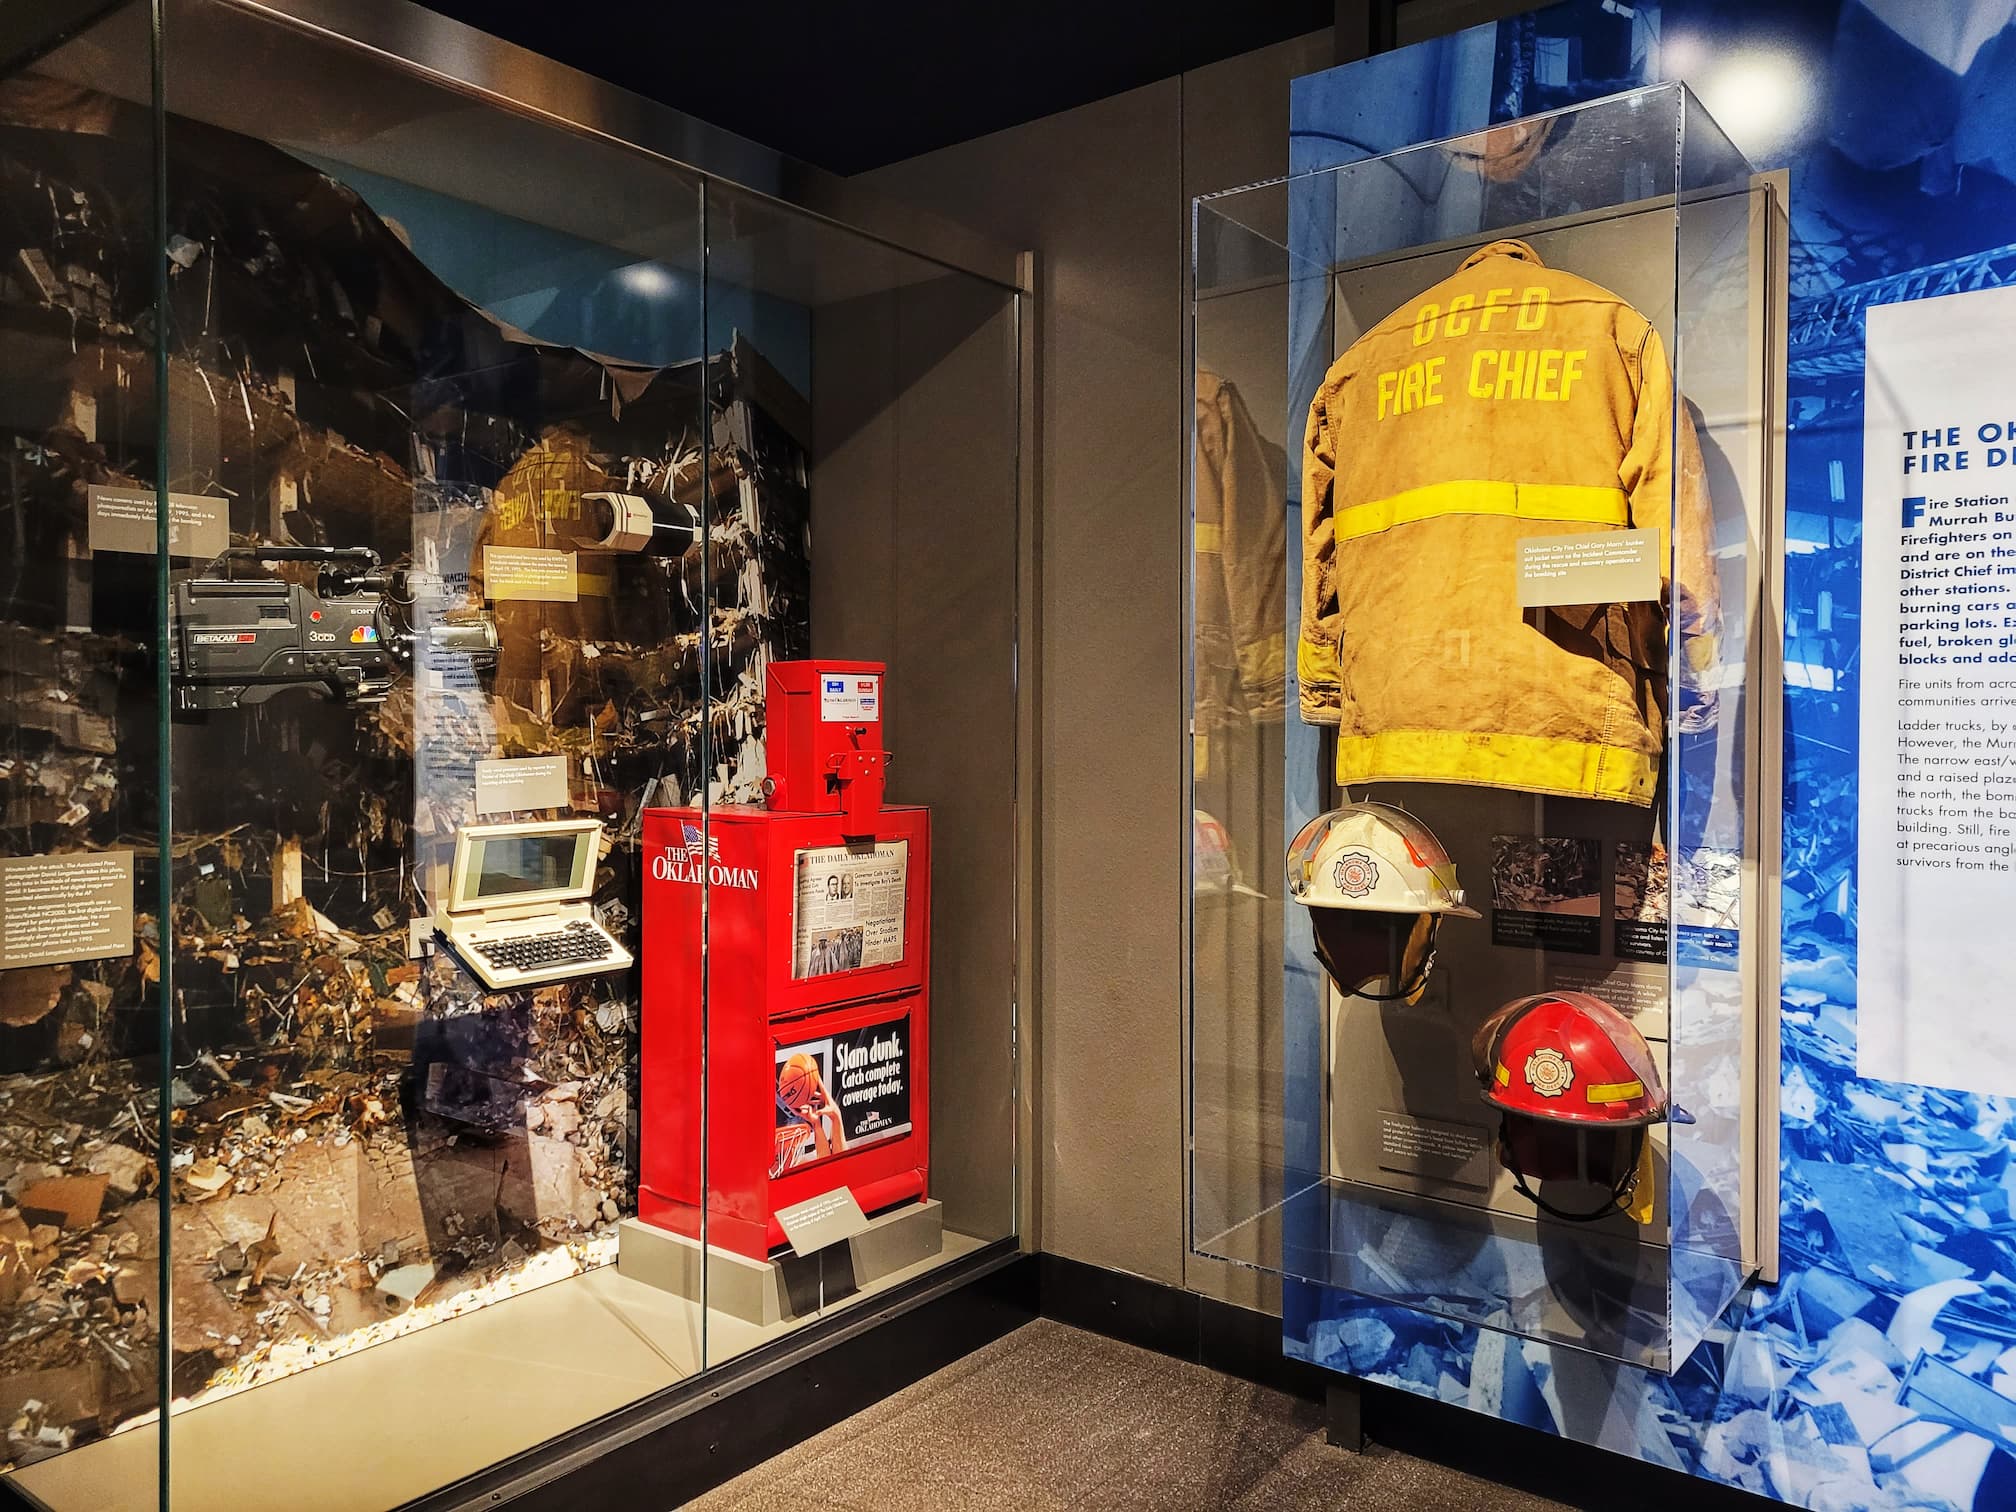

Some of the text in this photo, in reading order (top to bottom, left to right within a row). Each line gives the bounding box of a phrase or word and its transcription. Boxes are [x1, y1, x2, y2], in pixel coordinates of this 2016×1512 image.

[1413, 287, 1550, 347] OCFD
[1377, 350, 1587, 421] FIRE CHIEF
[1903, 427, 1960, 450] THE
[1904, 451, 1968, 474] FIRE
[1955, 495, 2008, 507] Station
[1930, 512, 1987, 526] Murrah
[1901, 532, 1986, 546] Firefighters
[1524, 546, 1551, 554] Oklahoma
[1901, 551, 1929, 562] and
[1935, 552, 1960, 560] are
[1966, 551, 1985, 559] on
[1901, 568, 1949, 579] District
[1954, 565, 1992, 576] Chief
[1900, 583, 2010, 596] other stations.
[1900, 602, 1961, 614] burning
[1968, 602, 1999, 611] cars
[1900, 619, 1959, 633] parking
[1966, 618, 1997, 628] lots.
[1899, 636, 1932, 648] fuel,
[1938, 635, 1992, 646] broken
[1899, 653, 1947, 664] blocks
[1952, 652, 1982, 663] and
[1899, 679, 1920, 689] Fire
[1925, 680, 1952, 689] units
[1957, 678, 1984, 689] from
[1898, 696, 1976, 706] communities
[1898, 720, 2007, 734] Ladder trucks, by
[1898, 737, 1956, 749] However,
[1963, 738, 1982, 748] the
[1898, 754, 1919, 764] The
[1898, 770, 1921, 782] and
[1940, 772, 1978, 782] raised
[1897, 787, 1916, 798] the
[1920, 788, 1956, 800] north,
[1962, 789, 1981, 800] the
[1897, 805, 1933, 816] trucks
[1939, 805, 1967, 816] from
[1974, 806, 1993, 818] the
[1897, 820, 2010, 837] building. Still, fire
[1897, 840, 1908, 849] at
[1913, 842, 1979, 852] precarious
[665, 846, 688, 862] THE
[810, 856, 826, 865] THE
[828, 854, 848, 864] DAILY
[1896, 857, 2008, 871] survivors from the
[866, 917, 896, 927] Negotiations
[865, 926, 898, 937] Over Stadium
[883, 935, 897, 945] MAPS
[836, 1031, 903, 1072] Slam dunk.
[841, 1061, 900, 1089] Catch complete
[842, 1078, 903, 1107] coverage today.
